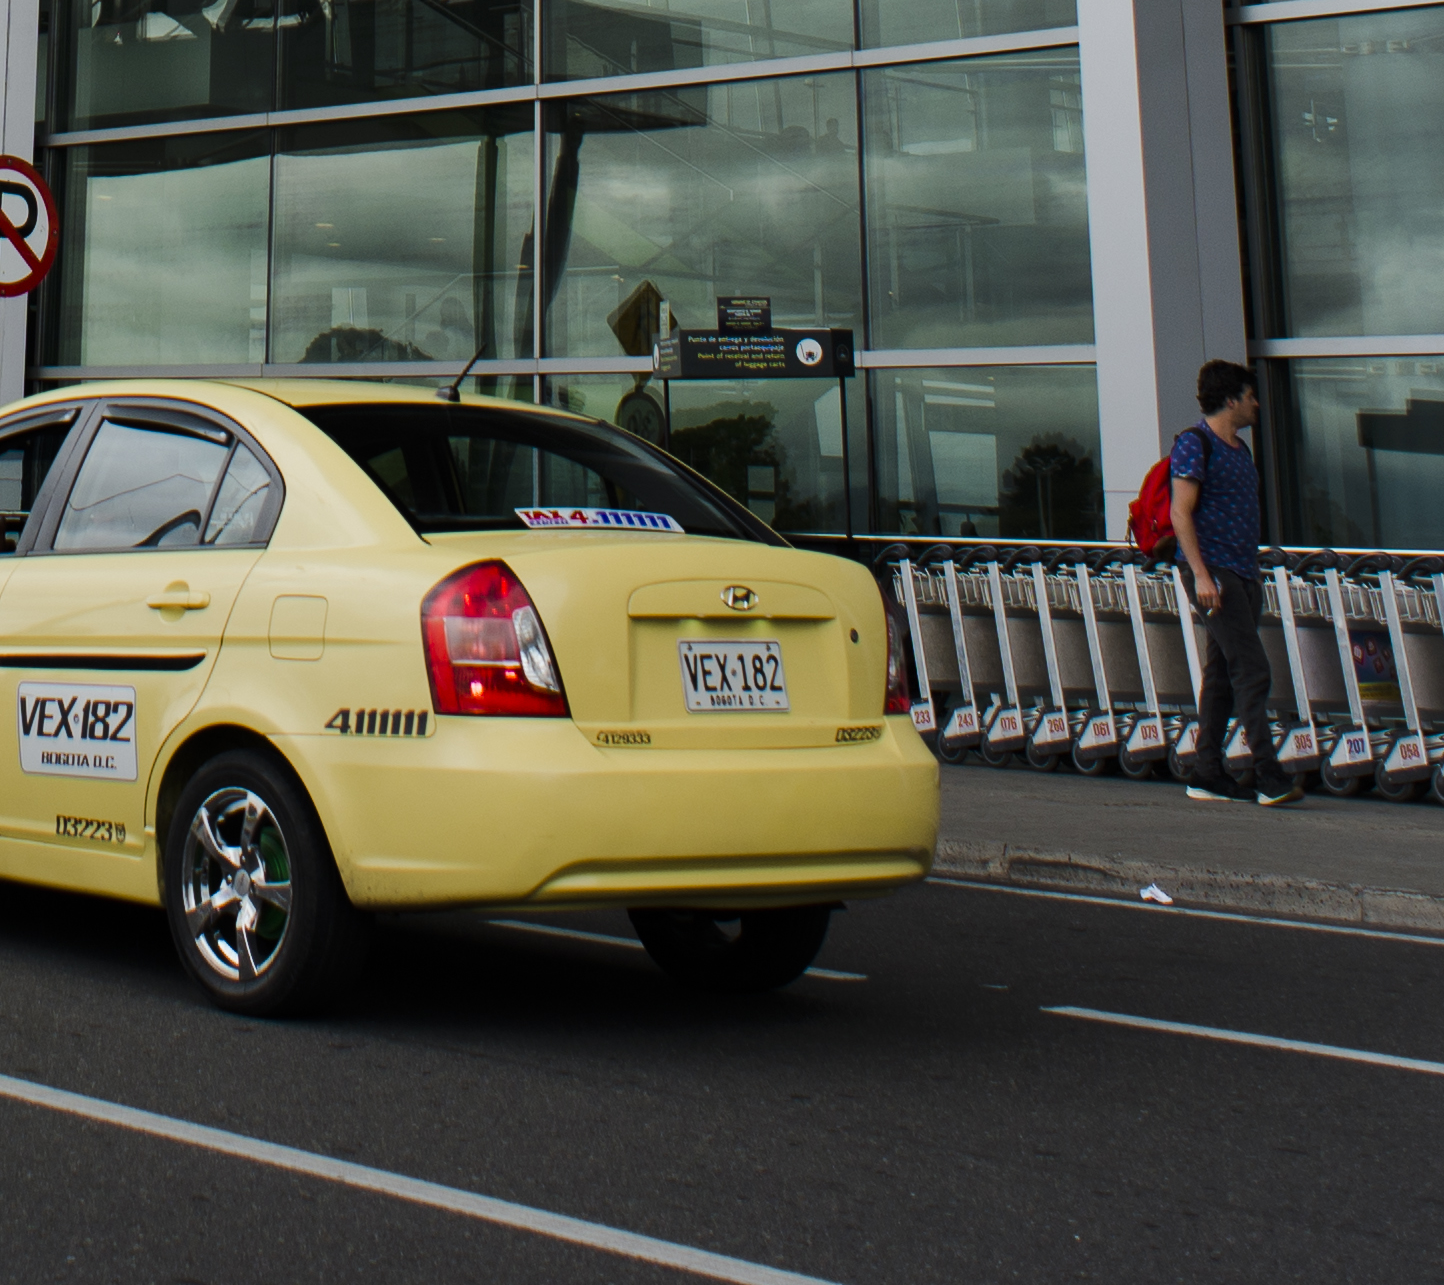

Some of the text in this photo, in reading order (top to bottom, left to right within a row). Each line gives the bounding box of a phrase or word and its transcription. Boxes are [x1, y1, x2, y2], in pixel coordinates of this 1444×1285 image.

[710, 695, 744, 707] BOGOTA
[914, 710, 931, 725] 233
[957, 713, 974, 728] 243
[1000, 717, 1017, 730] 076
[1047, 718, 1065, 732] 260
[1093, 722, 1110, 737] 061
[1140, 725, 1159, 740] 079
[1294, 734, 1313, 750] 305
[1346, 737, 1366, 754] 207
[41, 751, 117, 770] BOGOTA D.C.
